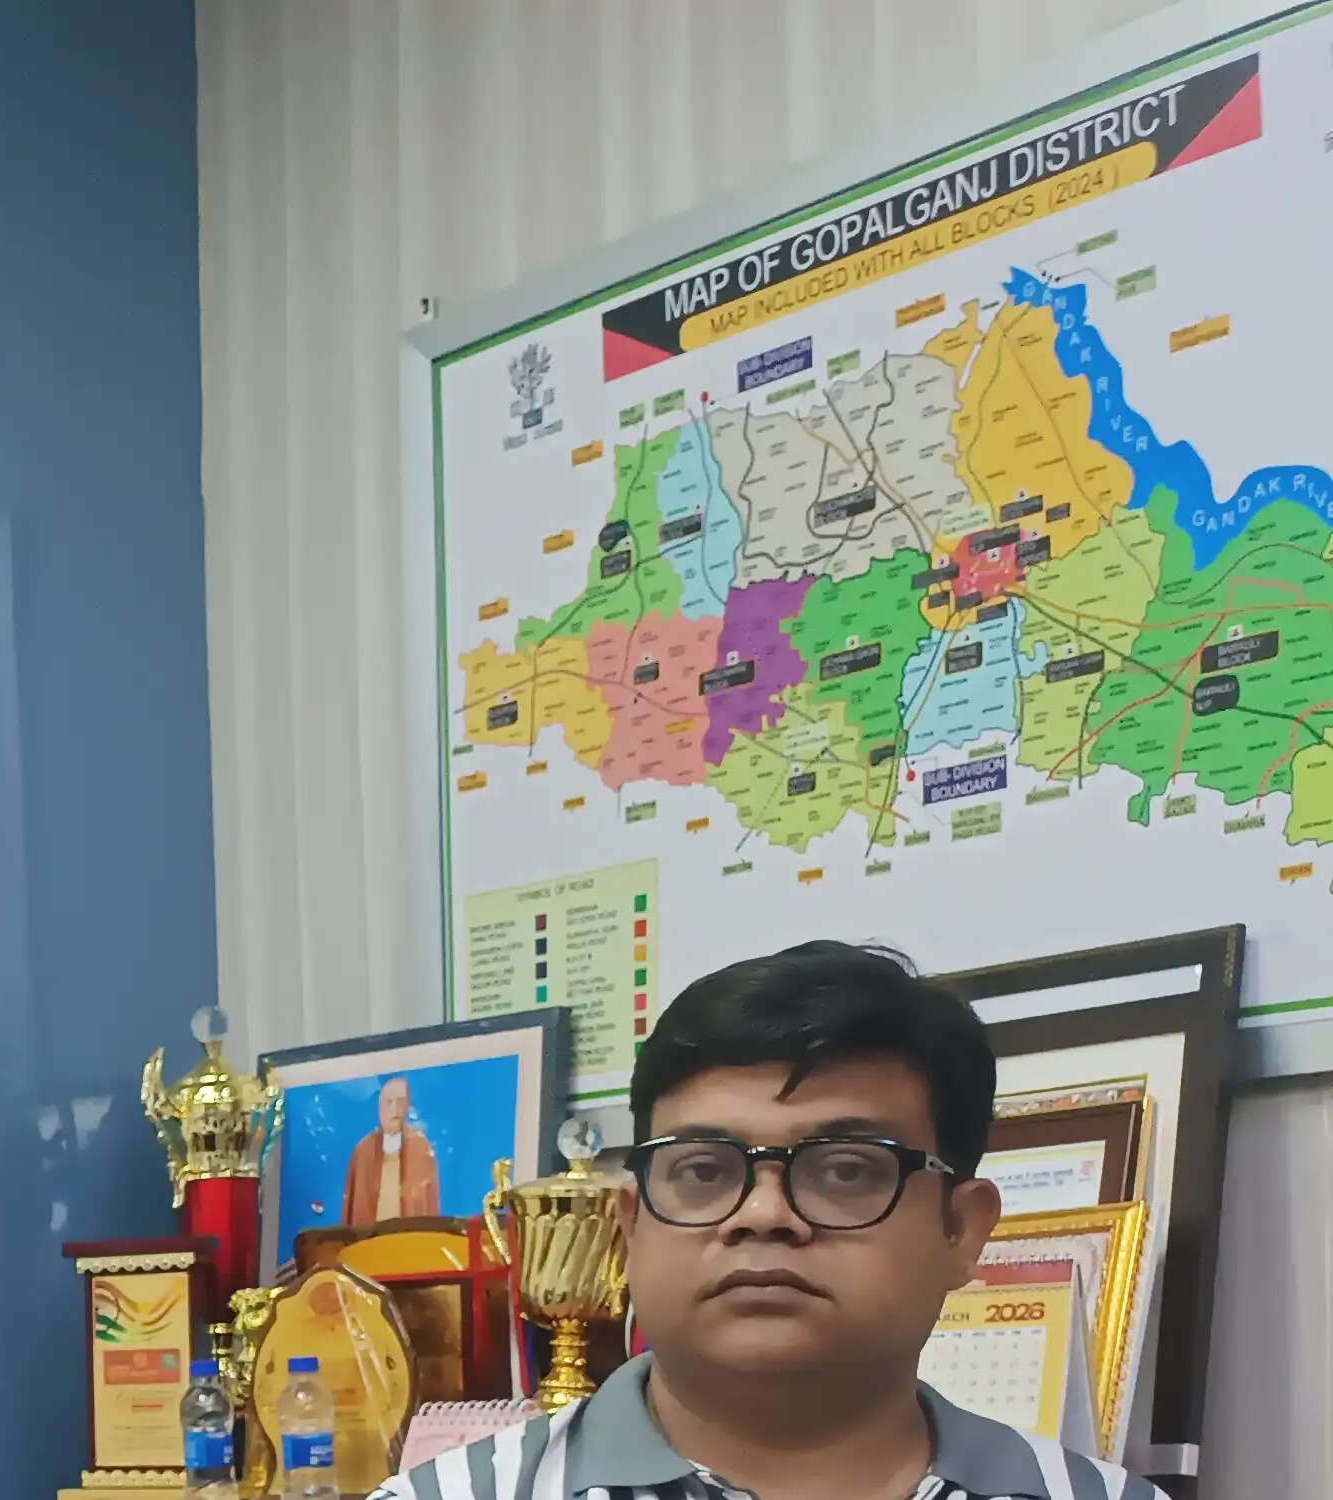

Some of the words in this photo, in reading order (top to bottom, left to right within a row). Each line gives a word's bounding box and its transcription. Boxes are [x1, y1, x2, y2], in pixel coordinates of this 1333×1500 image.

[664, 270, 730, 321] MAP
[738, 247, 783, 292] OF
[790, 159, 998, 272] GOPALGANJ
[1009, 85, 1186, 188] DISTRICT
[709, 302, 747, 335] MAP
[753, 267, 847, 318] INCLUDED
[853, 246, 903, 286] WITH
[909, 230, 946, 266] ALL
[951, 198, 1035, 246] BLOCKS
[1023, 282, 1092, 363] GANDAK
[1096, 376, 1148, 453] RIVER
[1192, 476, 1280, 534] GANDAK
[931, 775, 998, 801] BOUNDARY
[984, 1301, 1046, 1323] 2026
